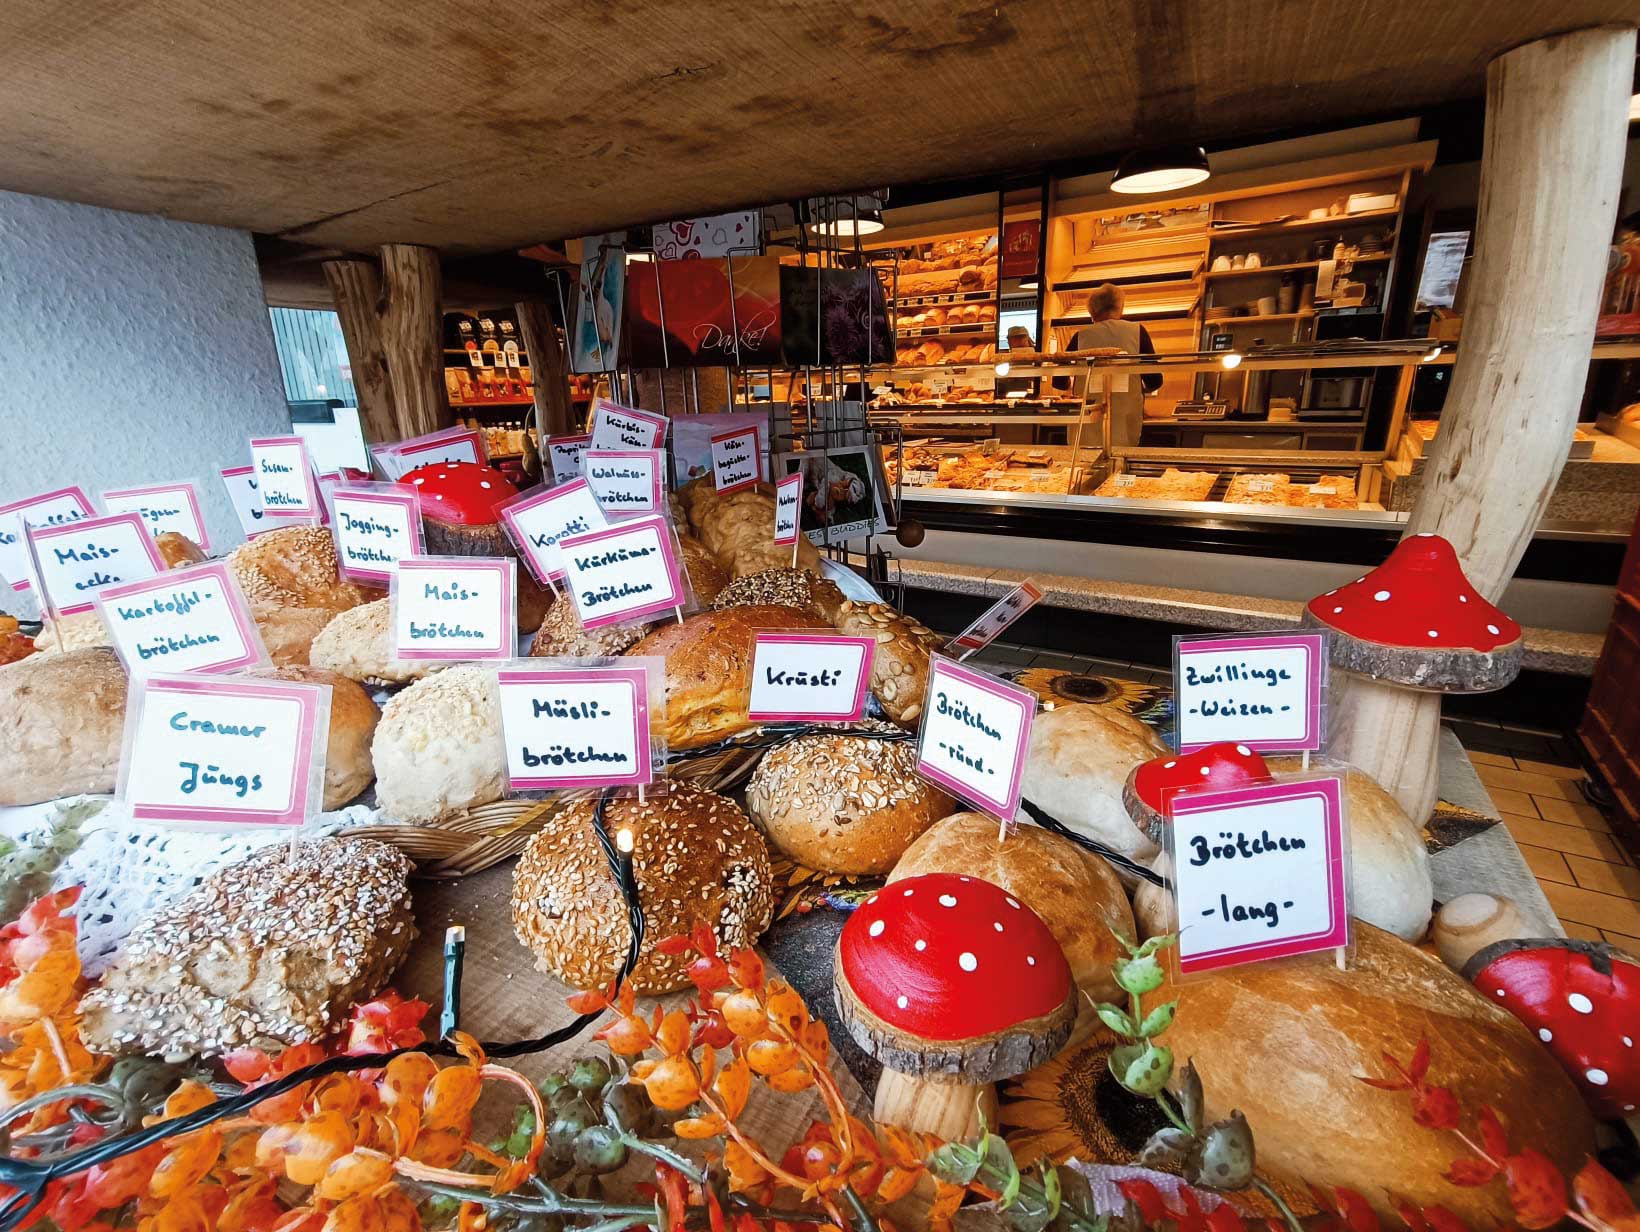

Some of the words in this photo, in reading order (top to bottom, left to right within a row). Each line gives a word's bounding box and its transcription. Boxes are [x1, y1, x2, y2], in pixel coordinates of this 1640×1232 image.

[693, 310, 777, 355] Danke!
[339, 512, 399, 538] Jogging-
[53, 543, 120, 565] Mais-
[347, 545, 398, 562] brötche
[424, 582, 479, 600] Mais-
[581, 582, 653, 607] Brötchen
[136, 632, 220, 660] brötchen
[531, 698, 611, 720] Müsli-
[936, 692, 1003, 741] Brötchen
[522, 744, 629, 768] brötchen
[1189, 830, 1306, 867] Brötchen
